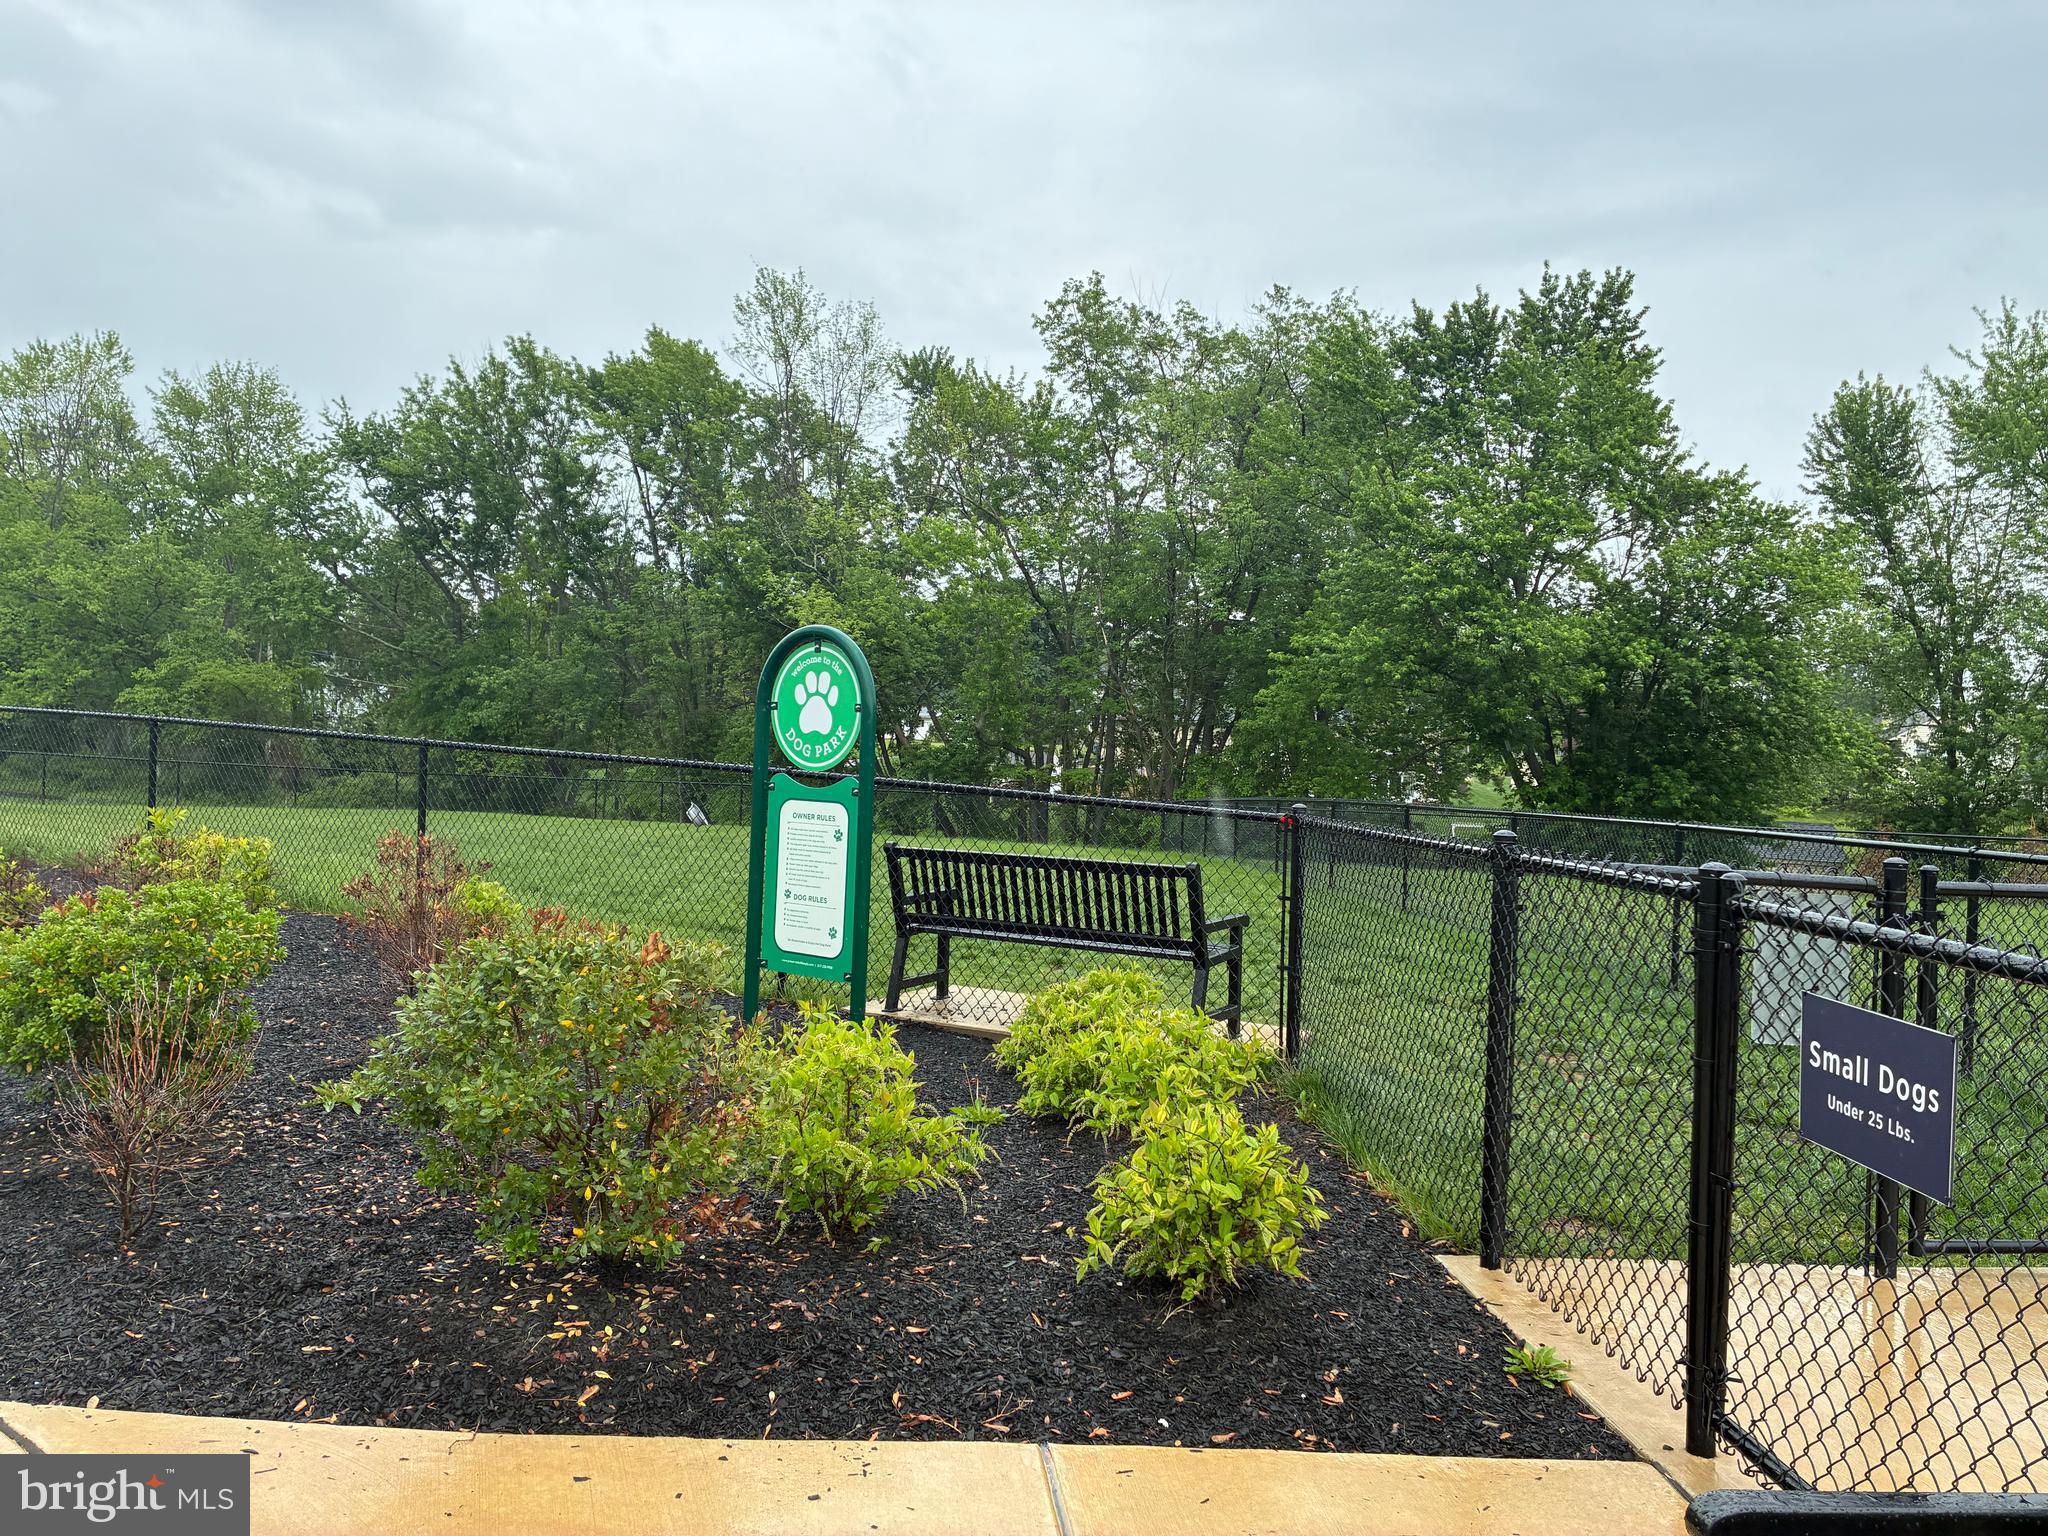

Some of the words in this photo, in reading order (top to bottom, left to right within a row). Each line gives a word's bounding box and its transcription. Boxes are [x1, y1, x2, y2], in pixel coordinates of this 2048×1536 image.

[791, 656, 822, 677] welcome
[823, 657, 832, 665] to
[832, 660, 843, 676] the
[786, 727, 811, 757] DOG
[815, 725, 847, 757] PARK
[792, 812, 815, 820] OWNER
[817, 814, 836, 822] RULES
[793, 893, 807, 902] DOG
[808, 895, 828, 904] RULES
[1809, 1040, 1869, 1086] Small
[1879, 1064, 1939, 1113] Dogs
[1827, 1094, 1864, 1121] Under
[1867, 1110, 1883, 1130] 25
[1888, 1118, 1915, 1144] Lbs.
